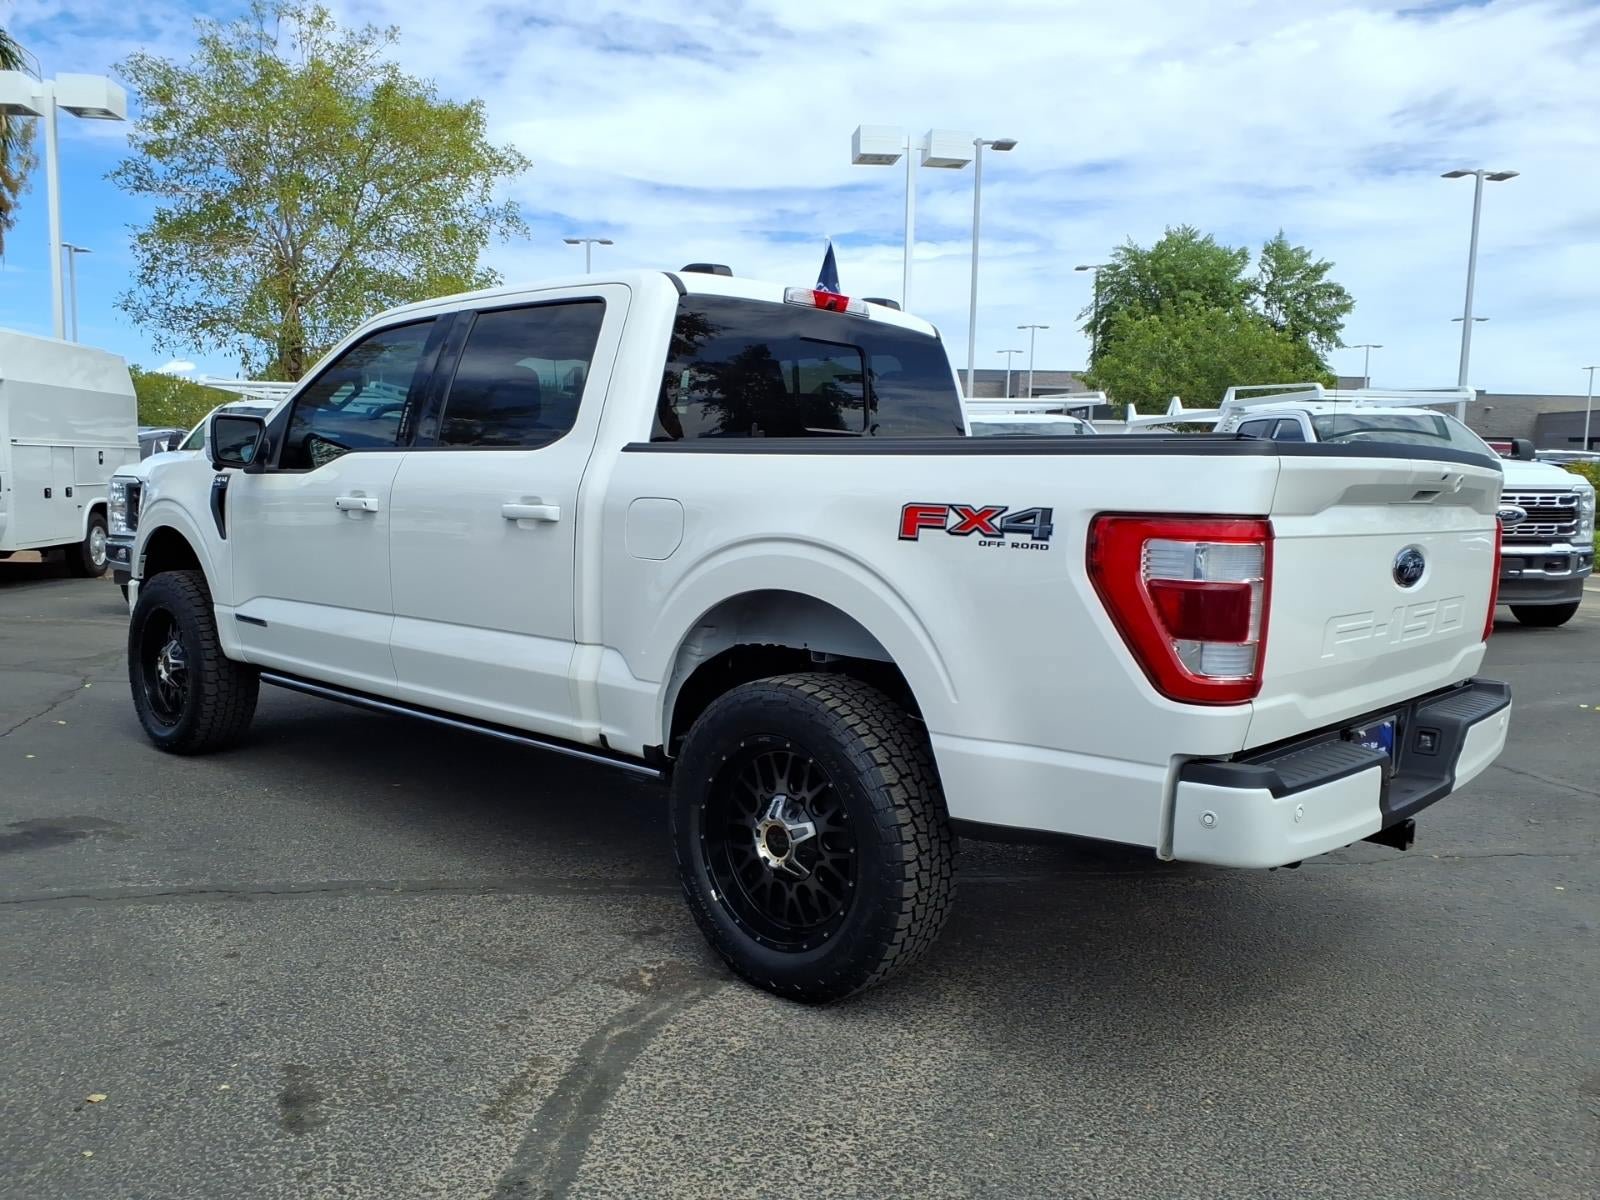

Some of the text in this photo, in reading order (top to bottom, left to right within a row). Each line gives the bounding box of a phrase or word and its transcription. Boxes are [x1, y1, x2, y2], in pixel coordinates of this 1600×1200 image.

[898, 502, 1053, 541] FX4
[1011, 542, 1049, 550] ROAD
[1321, 595, 1465, 658] F-150
